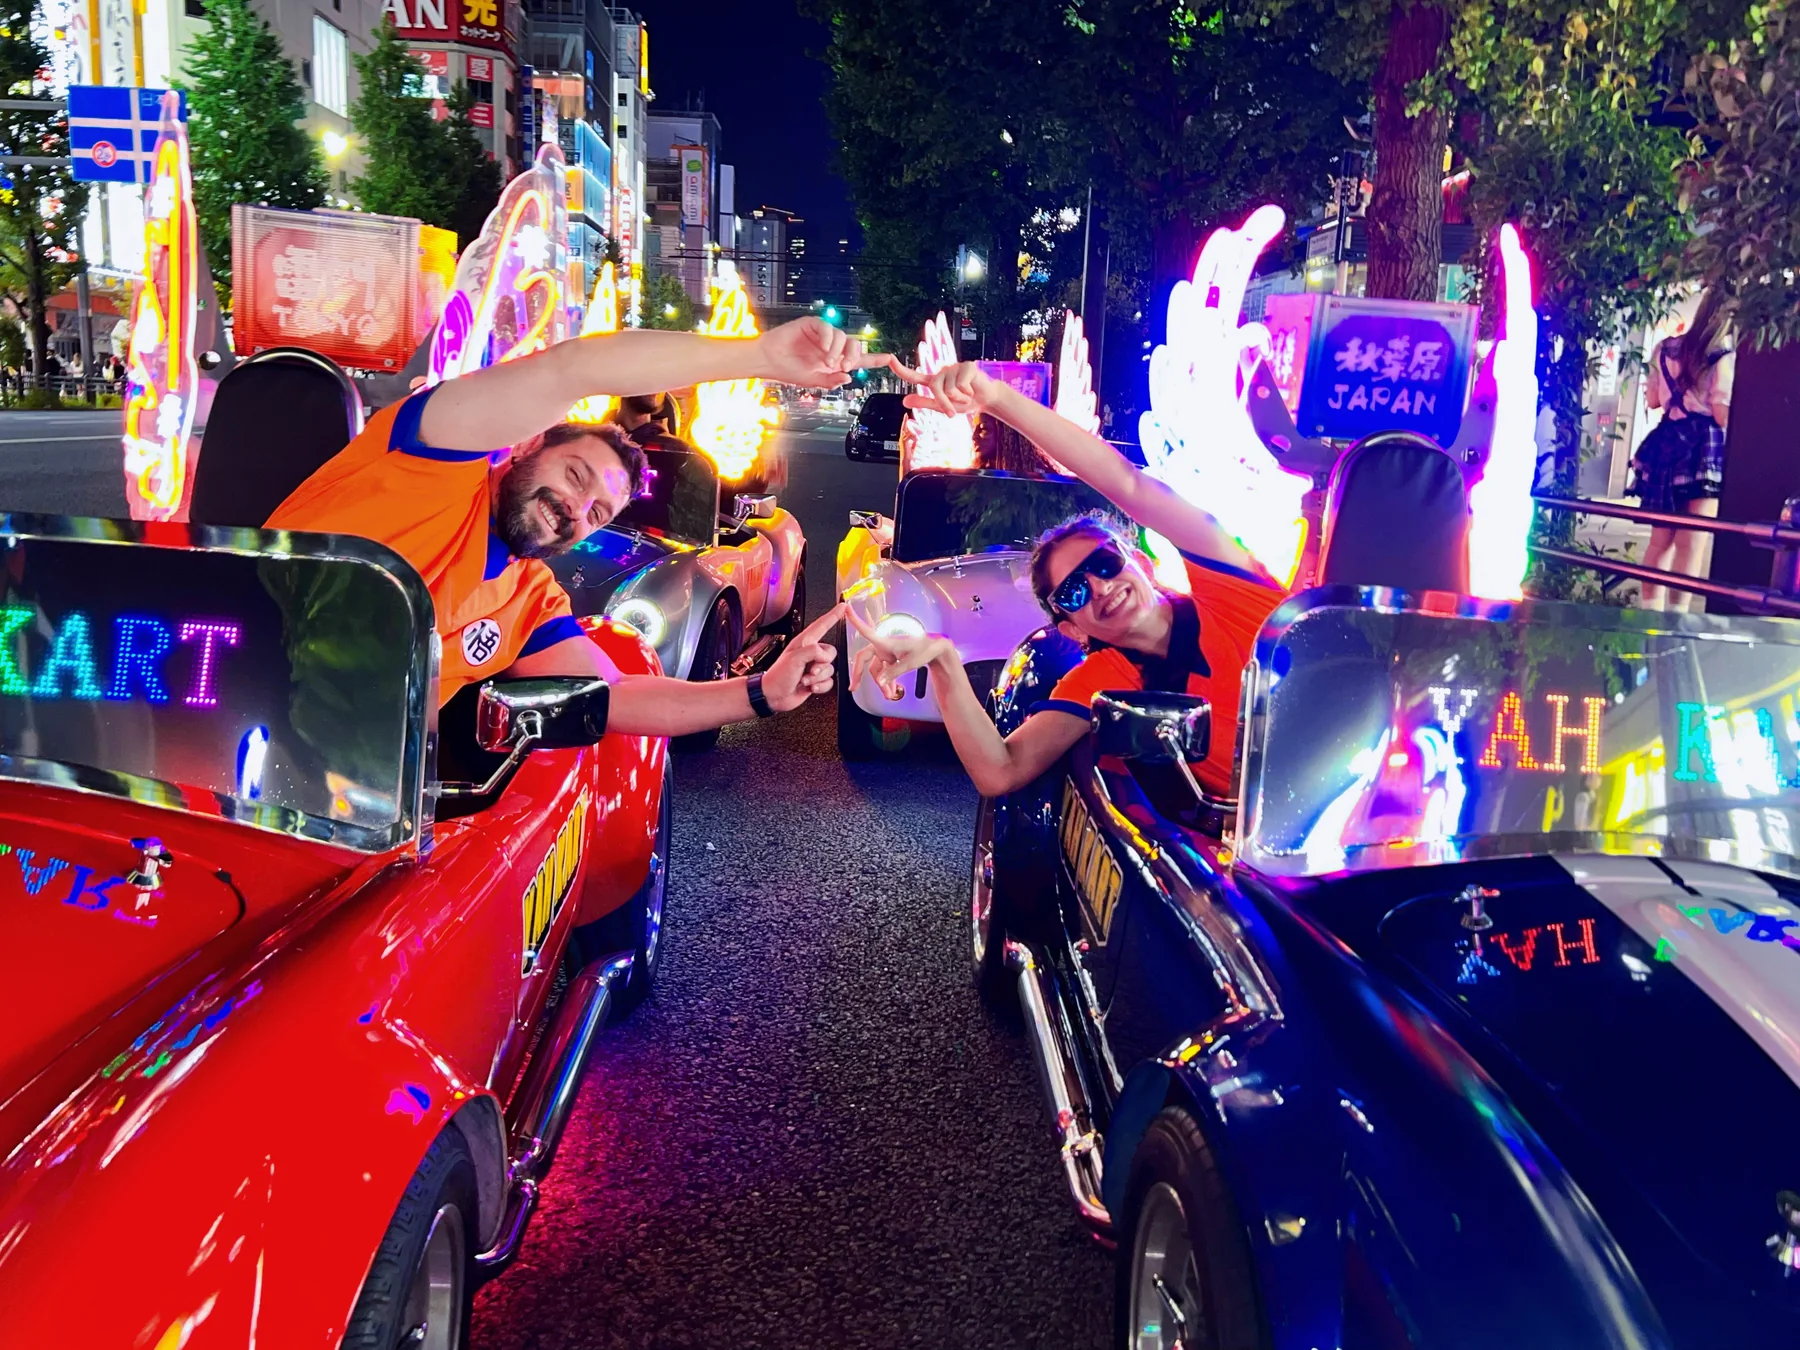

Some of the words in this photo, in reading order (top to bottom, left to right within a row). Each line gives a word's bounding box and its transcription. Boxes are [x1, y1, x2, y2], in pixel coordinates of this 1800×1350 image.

[1334, 335, 1443, 383] 秋葉原
[1328, 383, 1437, 416] JAPAN
[1428, 686, 1607, 775] YAH
